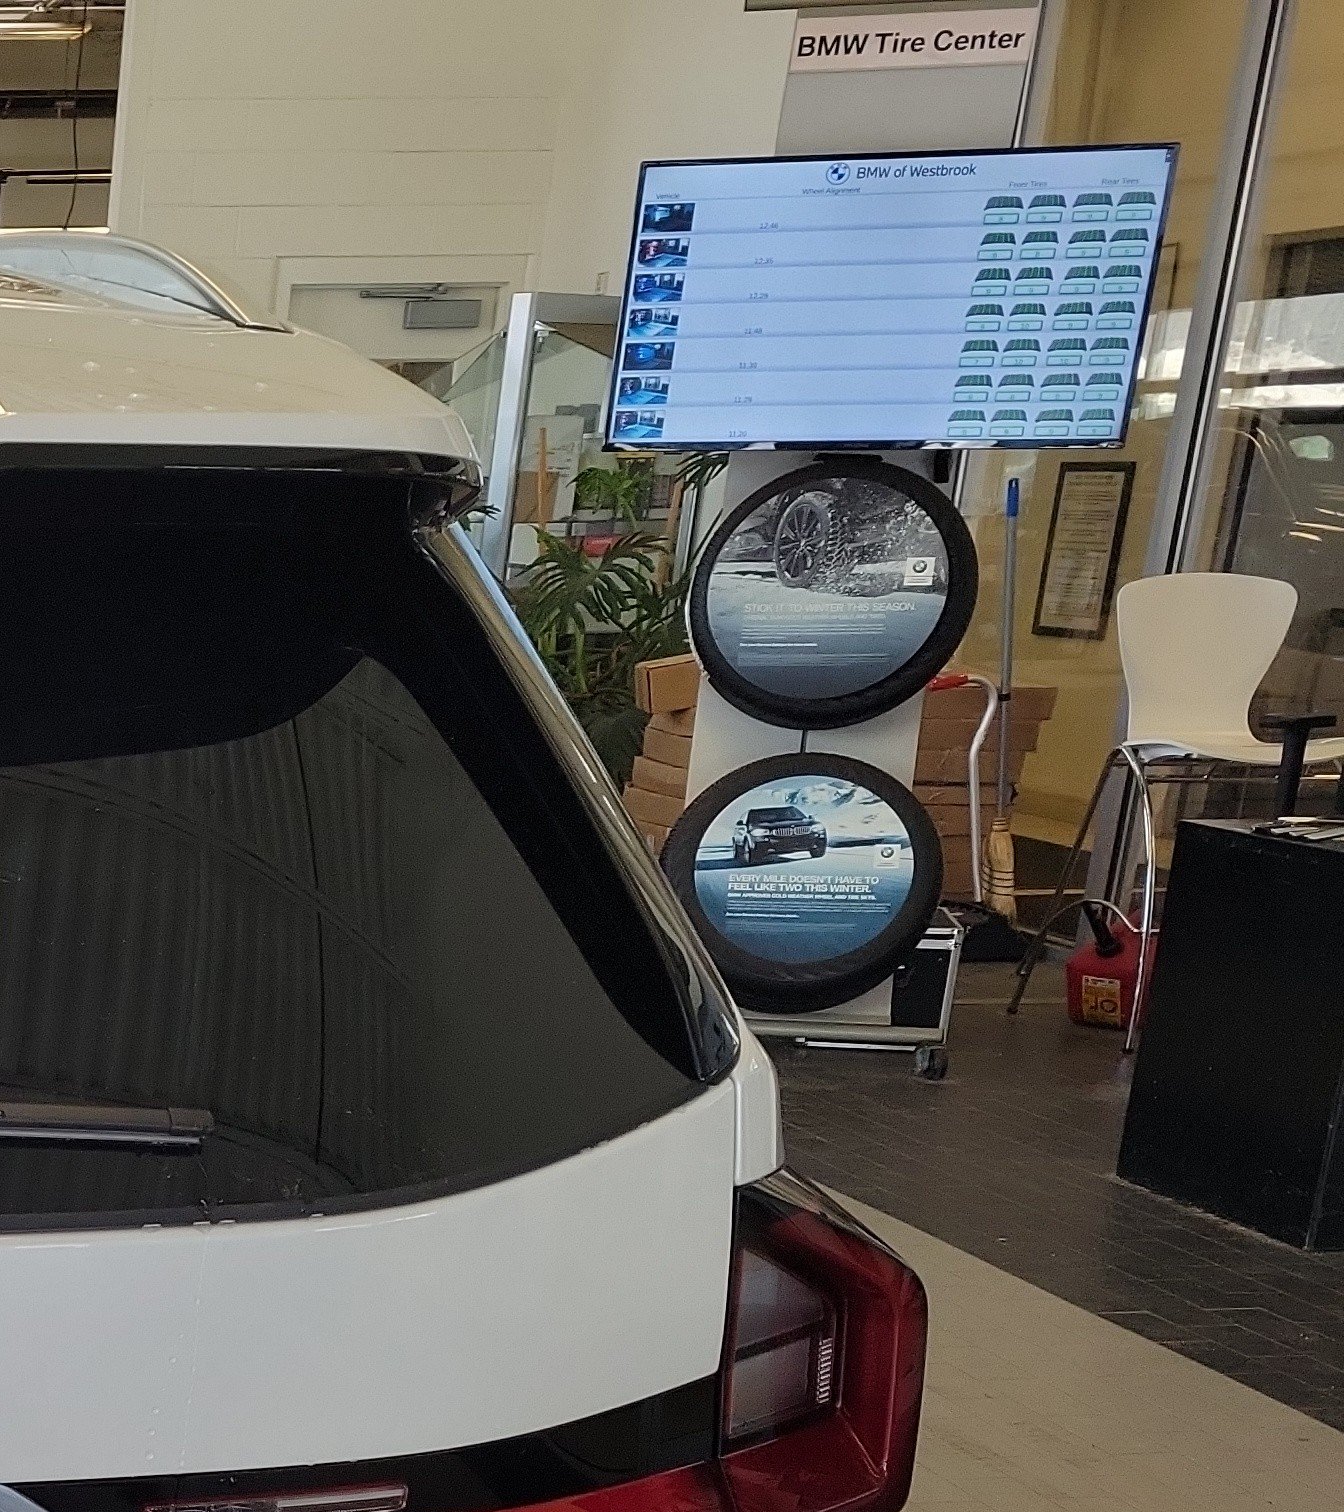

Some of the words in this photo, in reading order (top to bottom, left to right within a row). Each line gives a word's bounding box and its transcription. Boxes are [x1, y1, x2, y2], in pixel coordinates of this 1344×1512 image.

[797, 34, 869, 57] BMW
[875, 32, 925, 54] Tire
[933, 30, 1026, 52] Center
[856, 166, 890, 179] BMW
[894, 165, 907, 178] of
[910, 163, 977, 177] Westbrook
[789, 875, 832, 883] DOESN'T
[864, 876, 879, 884] TO
[778, 883, 802, 891] TWO
[804, 884, 828, 892] THIS
[830, 884, 871, 892] WINTER.
